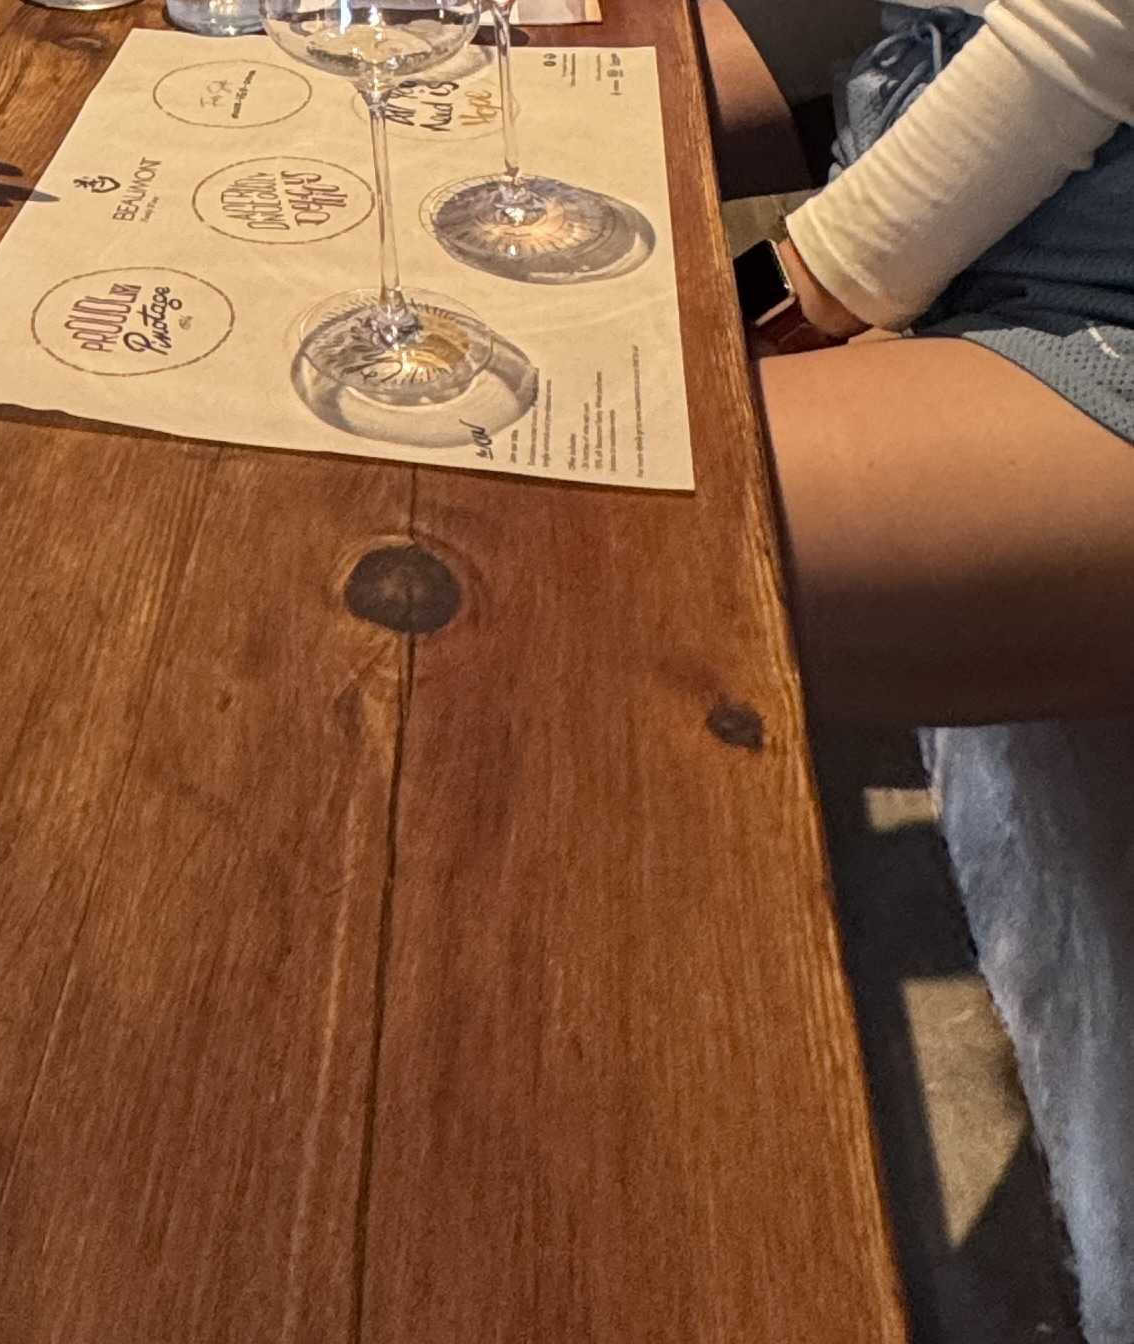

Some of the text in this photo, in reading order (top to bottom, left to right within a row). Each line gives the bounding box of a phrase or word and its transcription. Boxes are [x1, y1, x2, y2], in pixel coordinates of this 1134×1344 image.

[418, 79, 460, 97] is
[457, 88, 502, 127] Hope
[112, 156, 162, 222] BEAUMONT
[64, 282, 142, 352] PROUDLY
[122, 286, 183, 356] Pinotage
